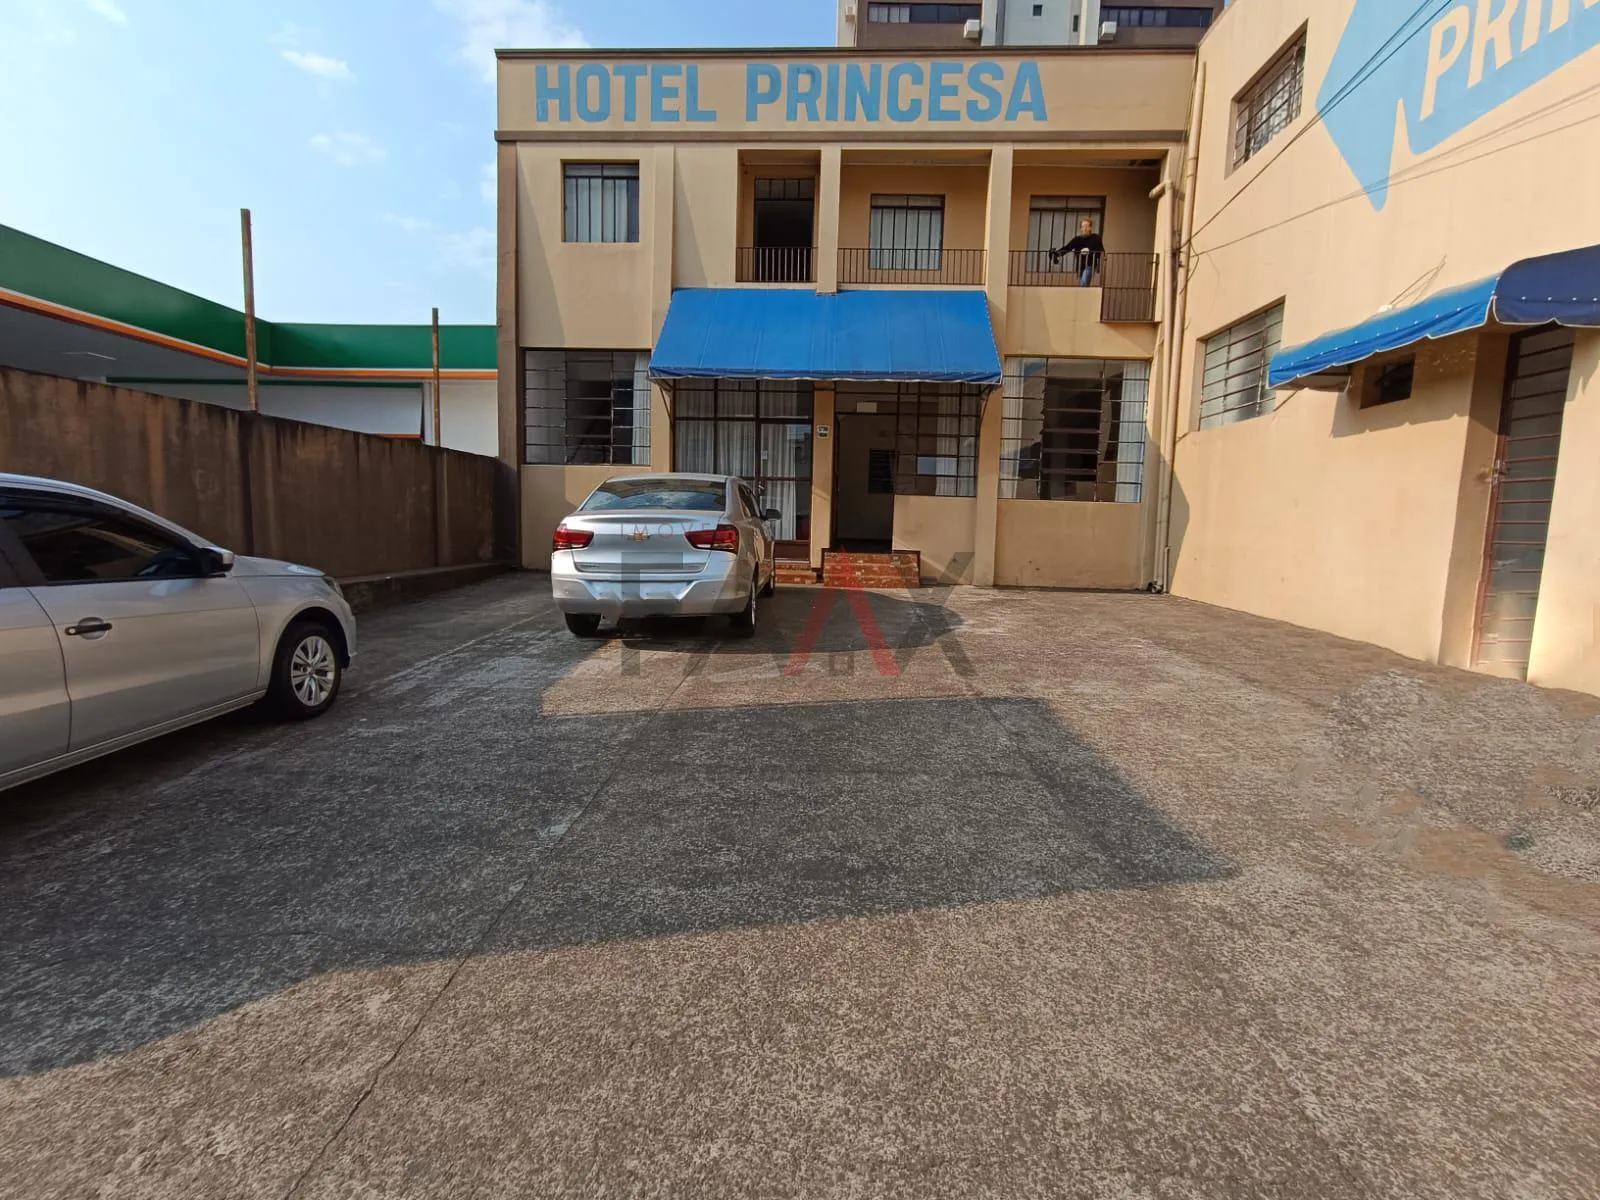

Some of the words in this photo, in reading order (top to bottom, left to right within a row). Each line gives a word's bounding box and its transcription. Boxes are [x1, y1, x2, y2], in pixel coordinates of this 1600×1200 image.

[535, 63, 717, 122] HOTEL
[745, 60, 1048, 122] PRINCESA
[1420, 0, 1599, 122] PR
